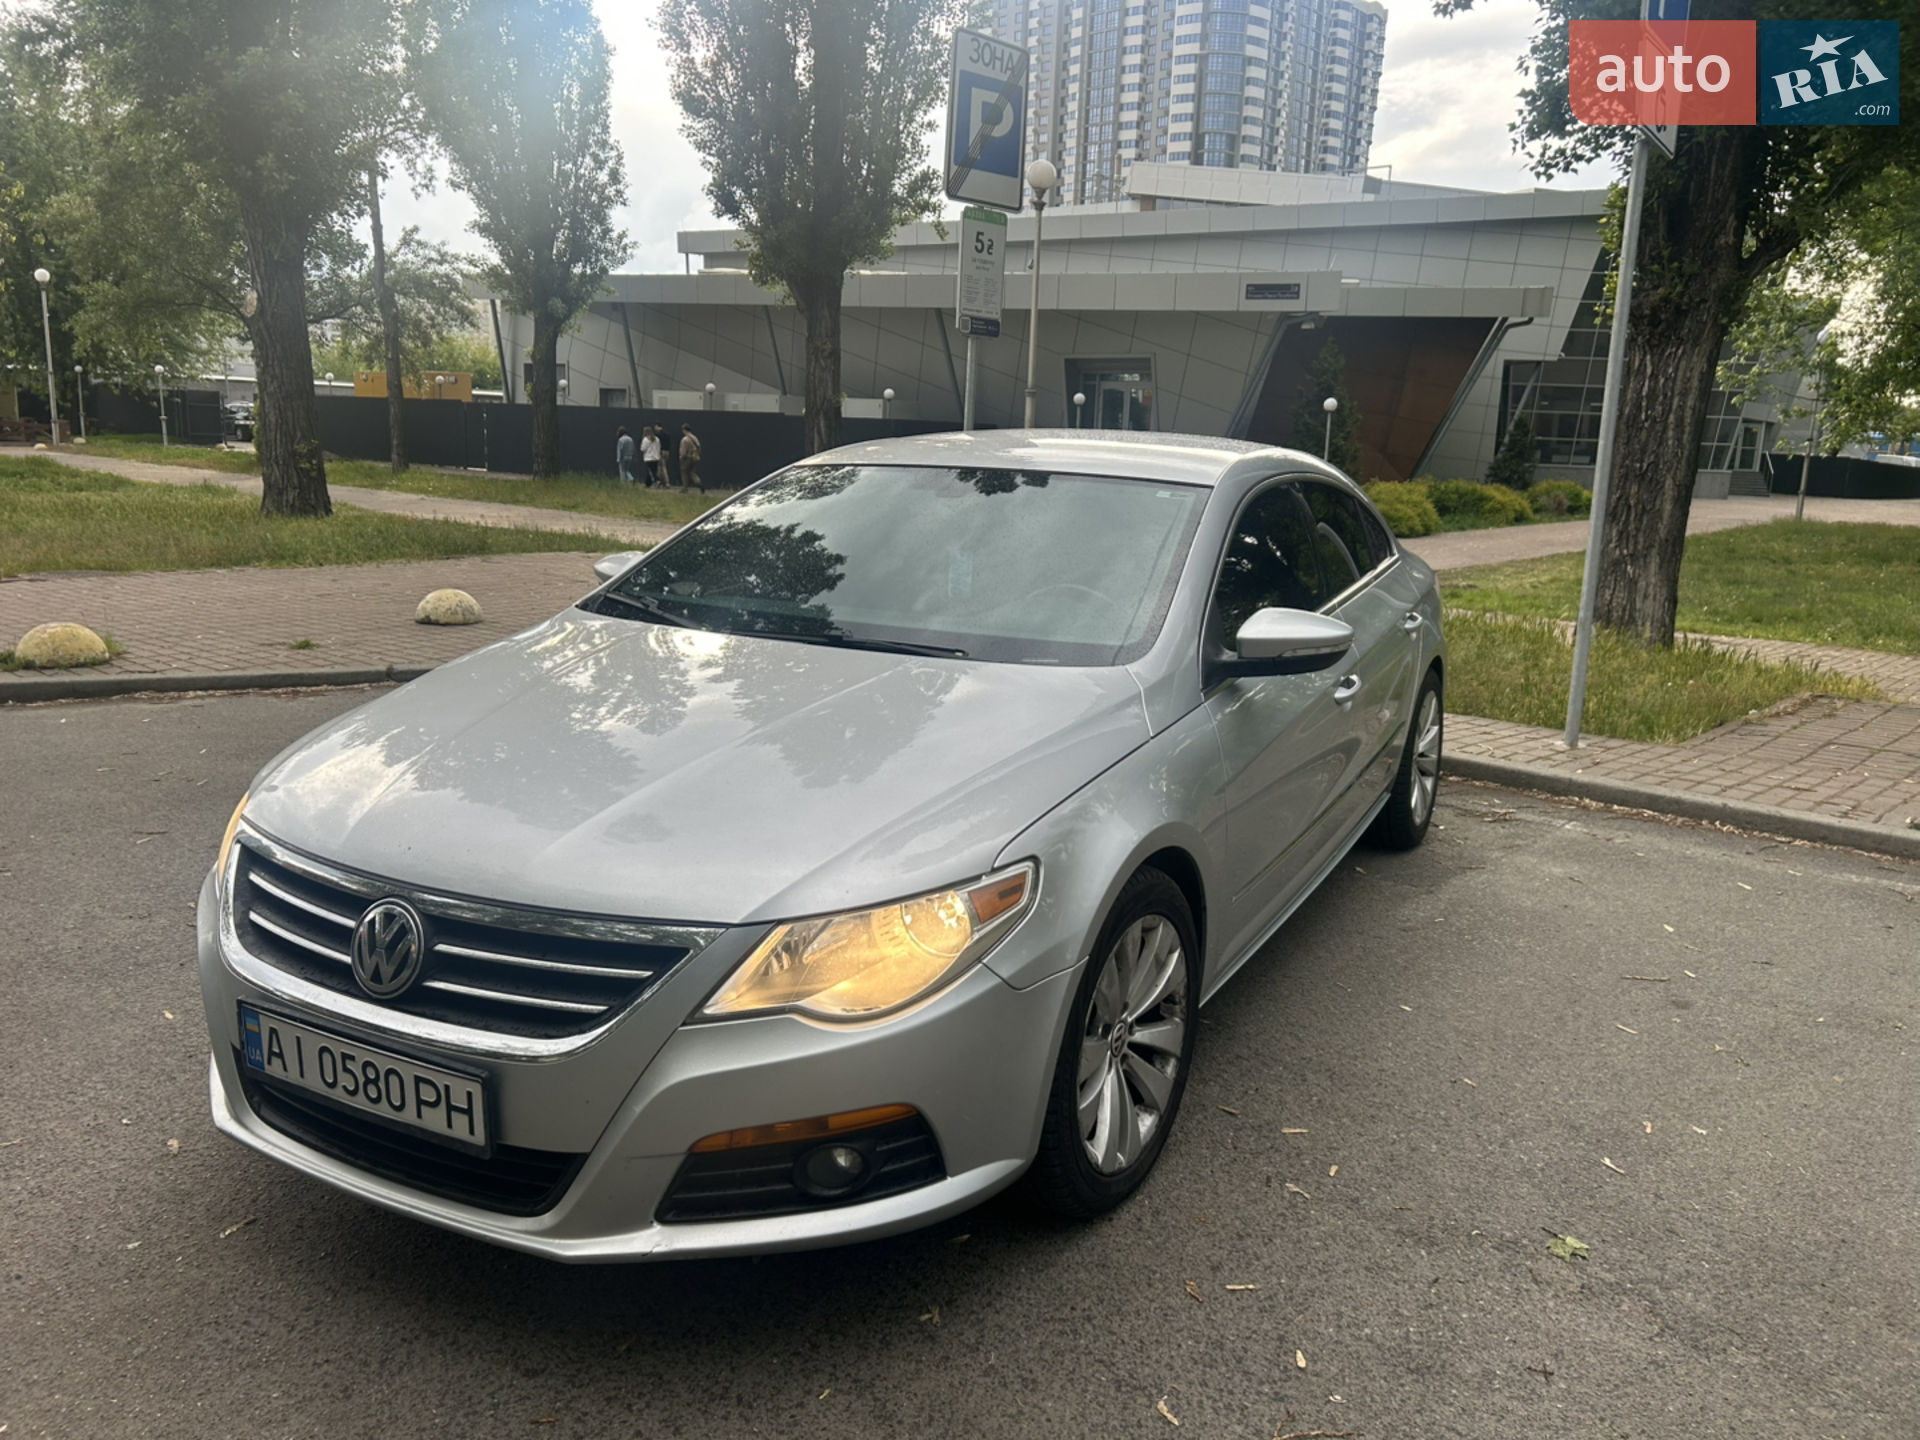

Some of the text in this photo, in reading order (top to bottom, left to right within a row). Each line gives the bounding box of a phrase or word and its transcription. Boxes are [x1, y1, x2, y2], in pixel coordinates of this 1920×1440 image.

[969, 37, 1016, 75] ЗОНА
[968, 87, 1014, 159] P
[248, 1046, 263, 1063] UA
[317, 1044, 406, 1113] 0580
